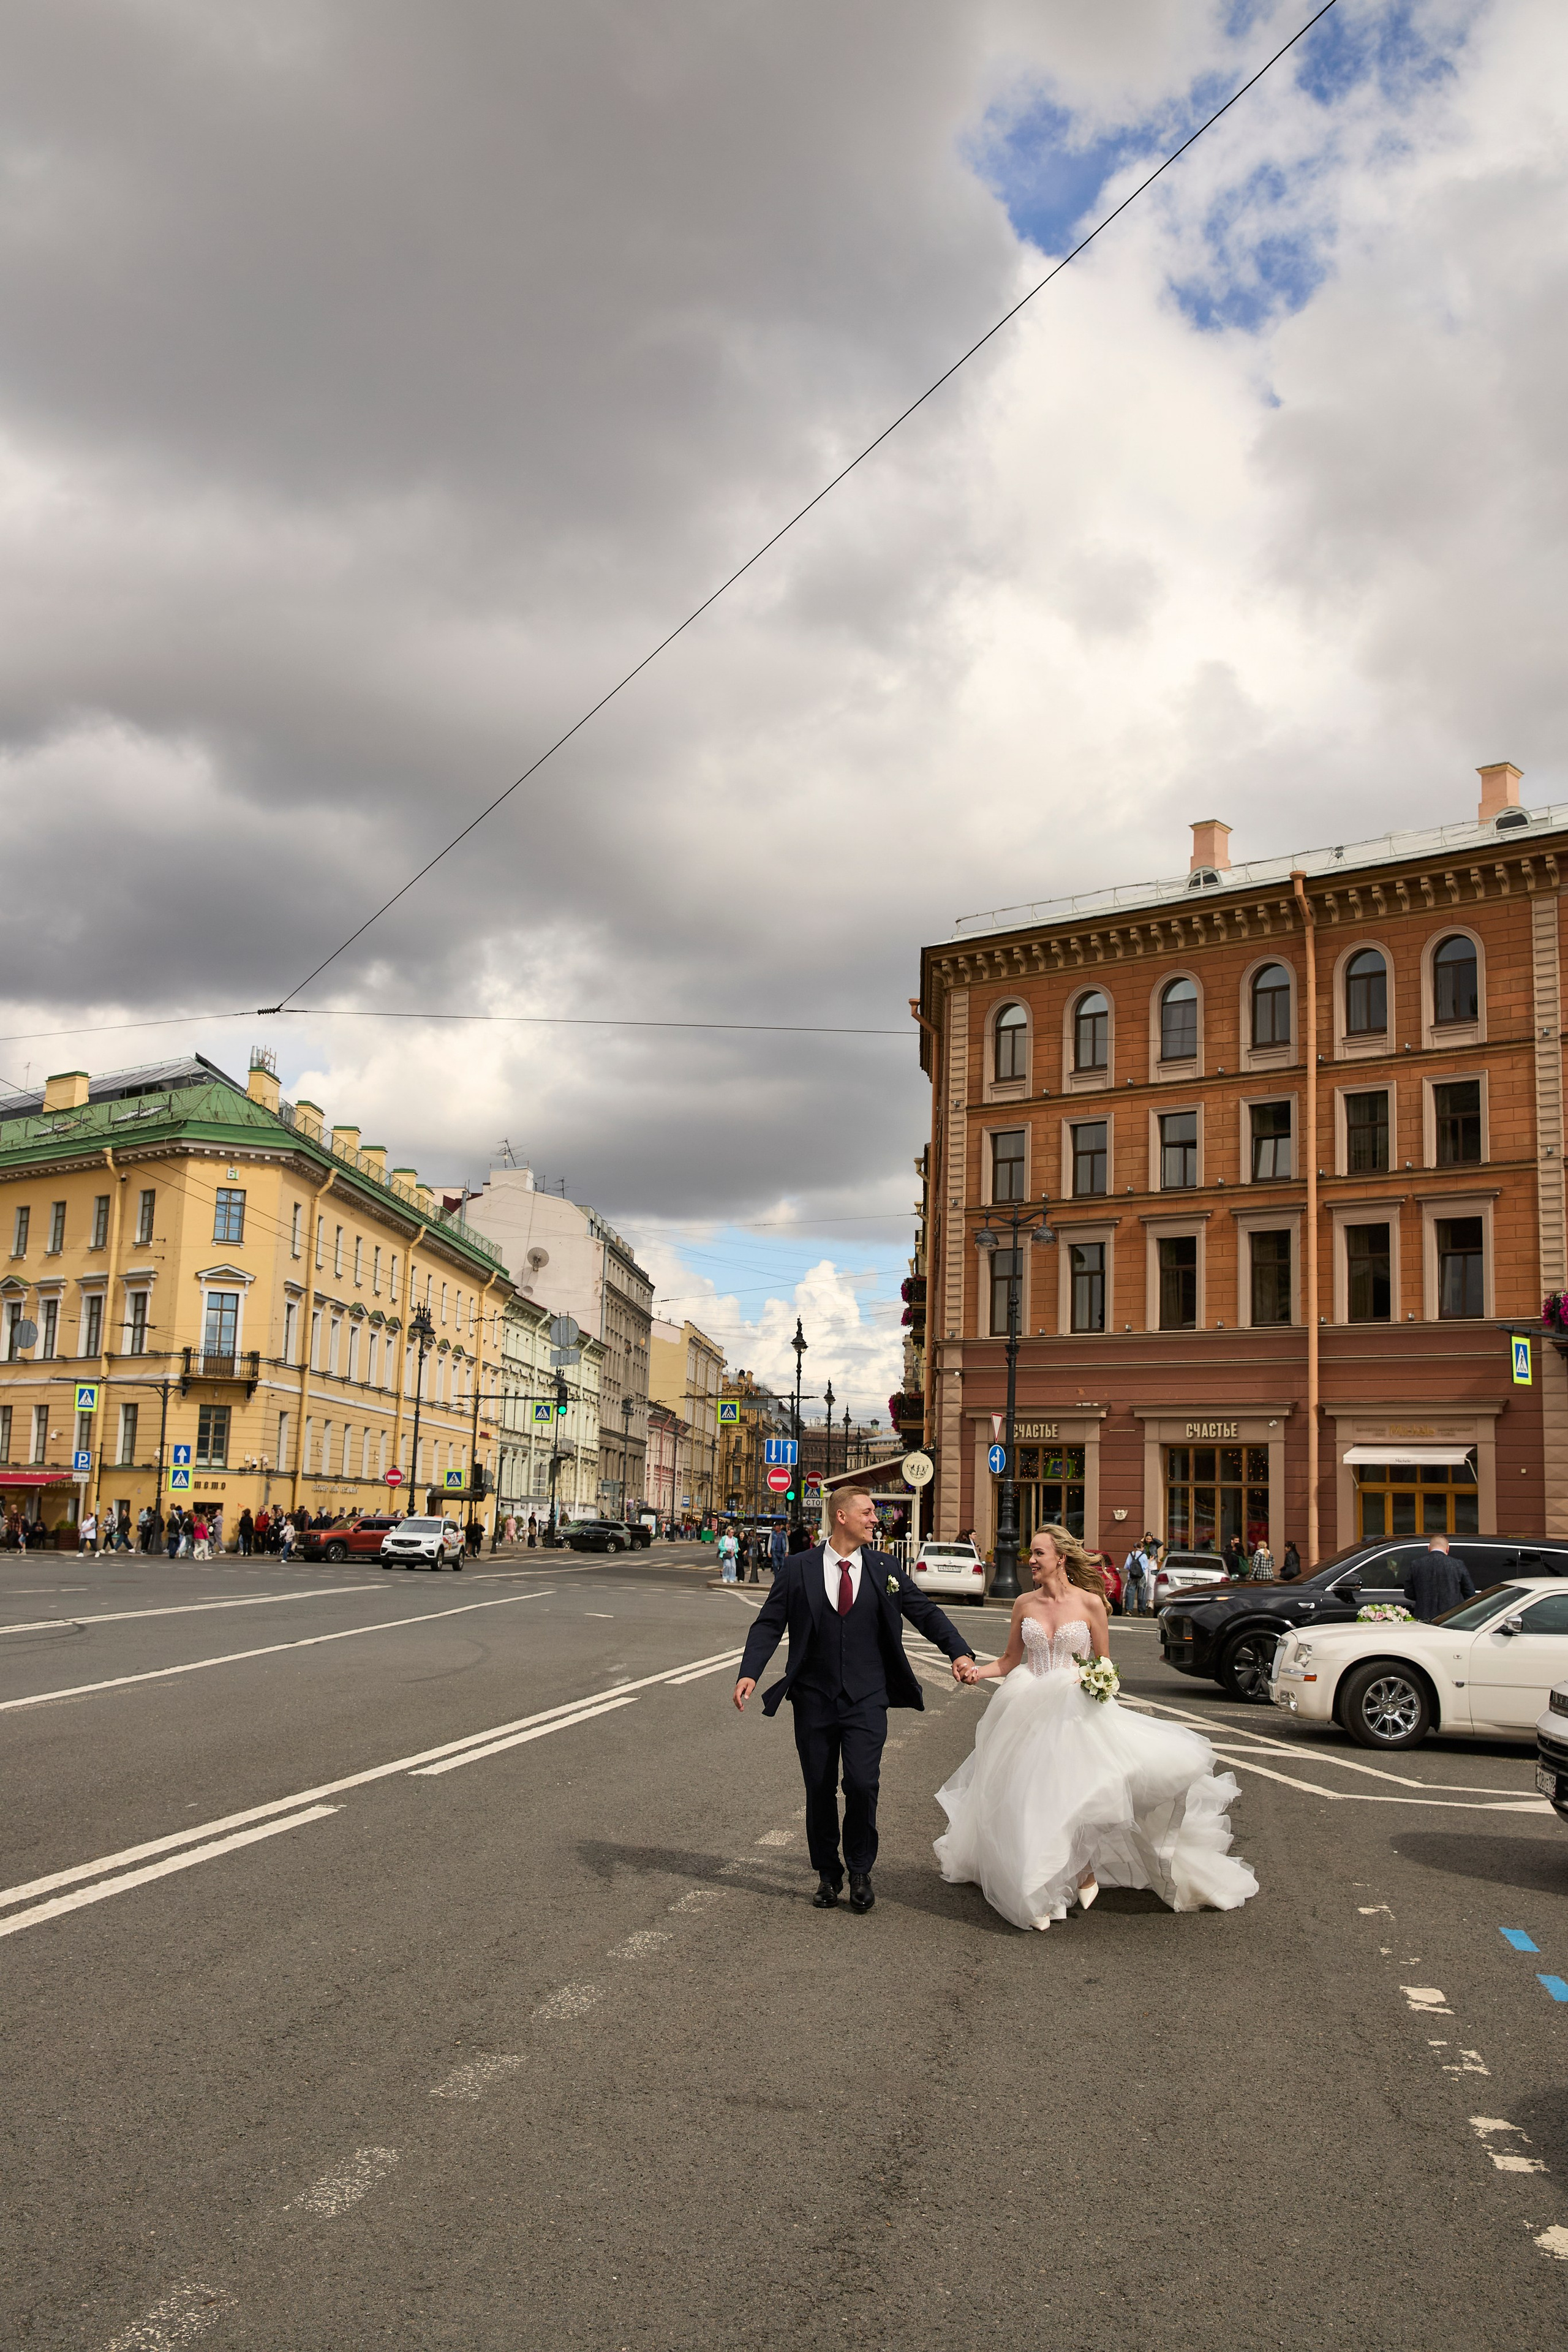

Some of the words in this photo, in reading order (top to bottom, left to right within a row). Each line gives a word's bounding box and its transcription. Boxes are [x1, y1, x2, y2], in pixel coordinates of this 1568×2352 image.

[1014, 1423, 1058, 1438] СЧАСТЬЕ
[1186, 1422, 1237, 1438] СЧАСТЬЕ
[194, 1481, 226, 1490] memo
